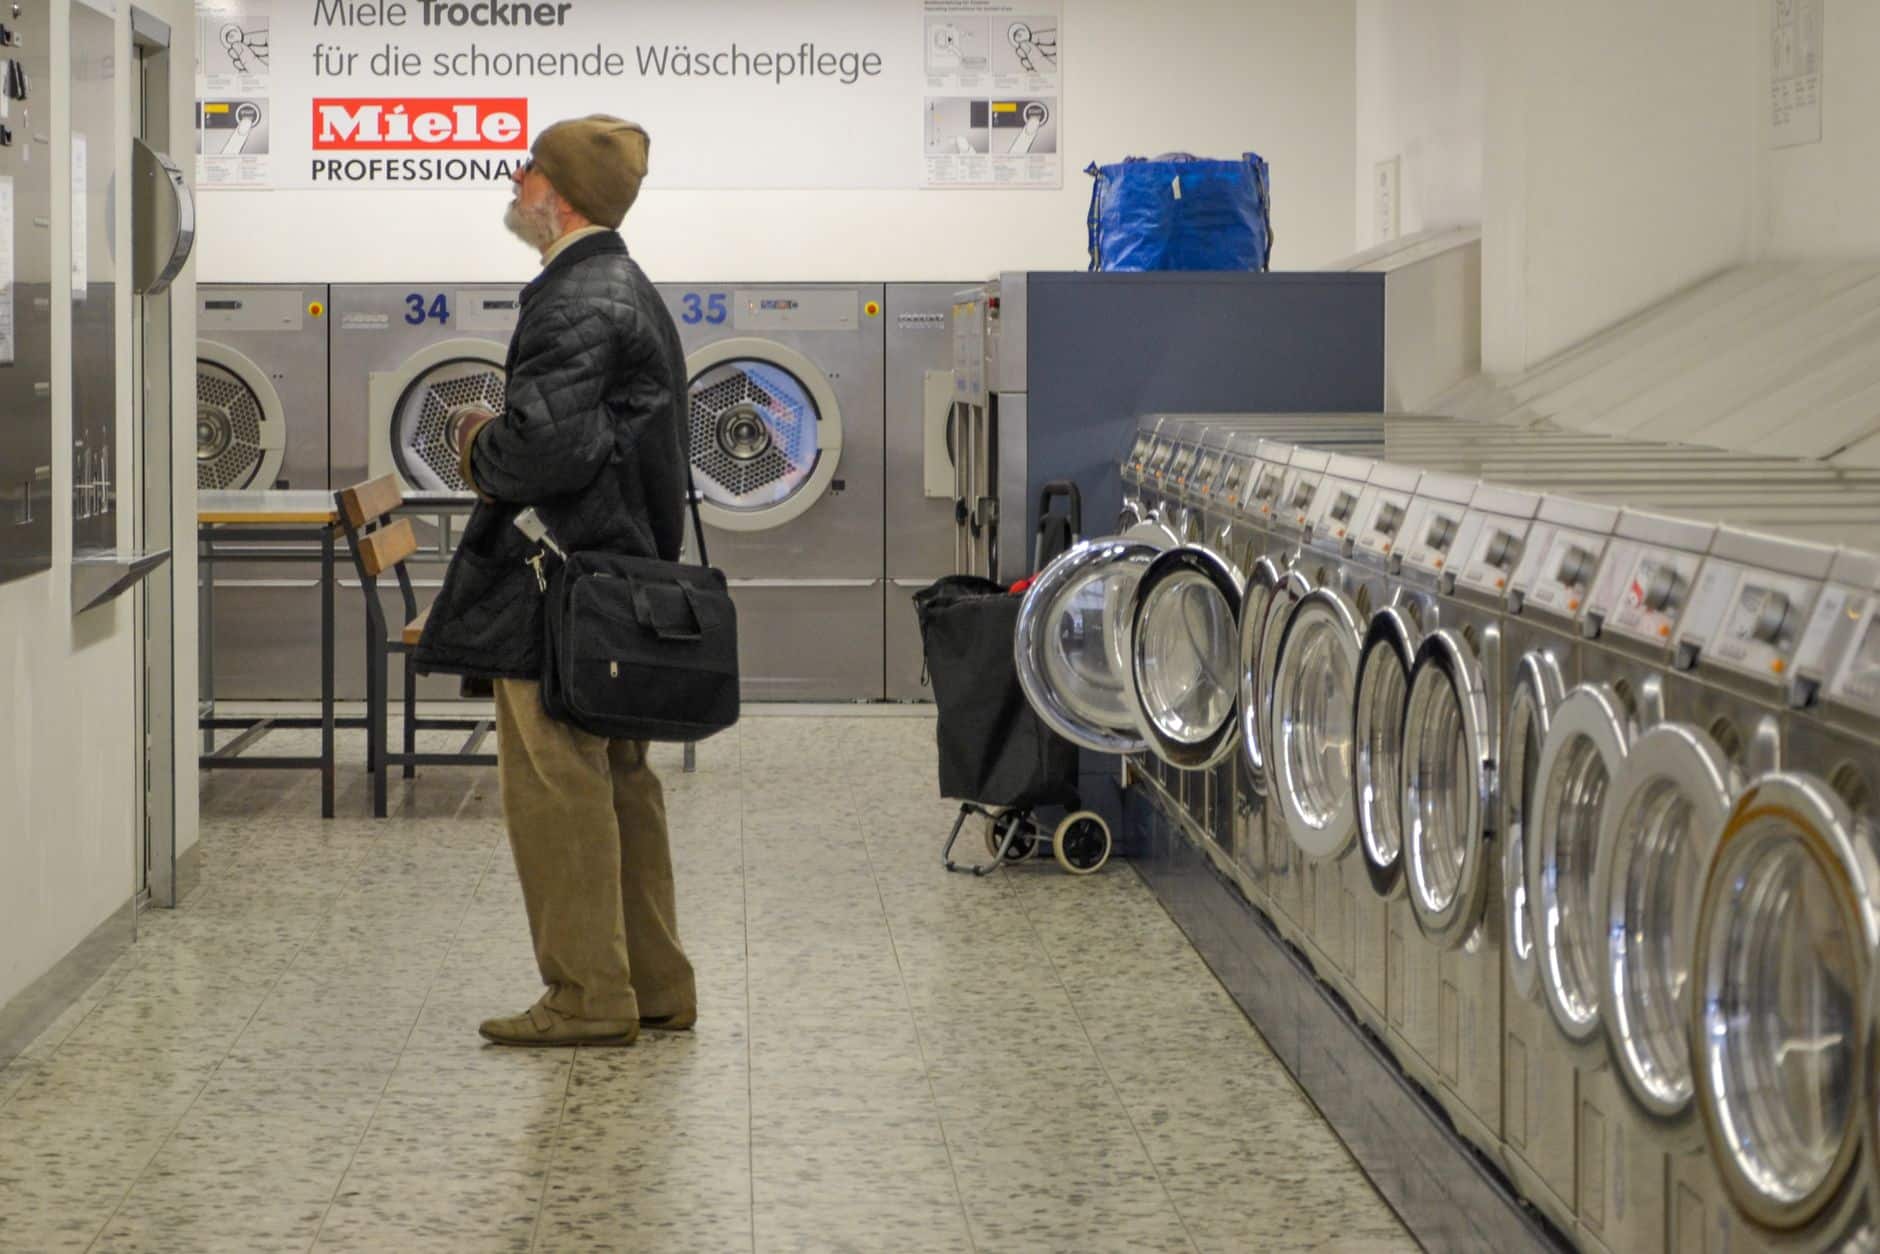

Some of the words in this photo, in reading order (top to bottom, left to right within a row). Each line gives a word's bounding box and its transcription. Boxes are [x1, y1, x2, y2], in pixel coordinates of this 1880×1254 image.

[313, 0, 407, 26] Miele
[416, 0, 573, 26] Trockner
[312, 43, 359, 77] für
[369, 43, 422, 77] die
[432, 42, 625, 77] schonende
[635, 42, 883, 85] Wäschepflege
[318, 104, 522, 143] Miele
[404, 293, 450, 326] 34
[682, 293, 728, 325] 35
